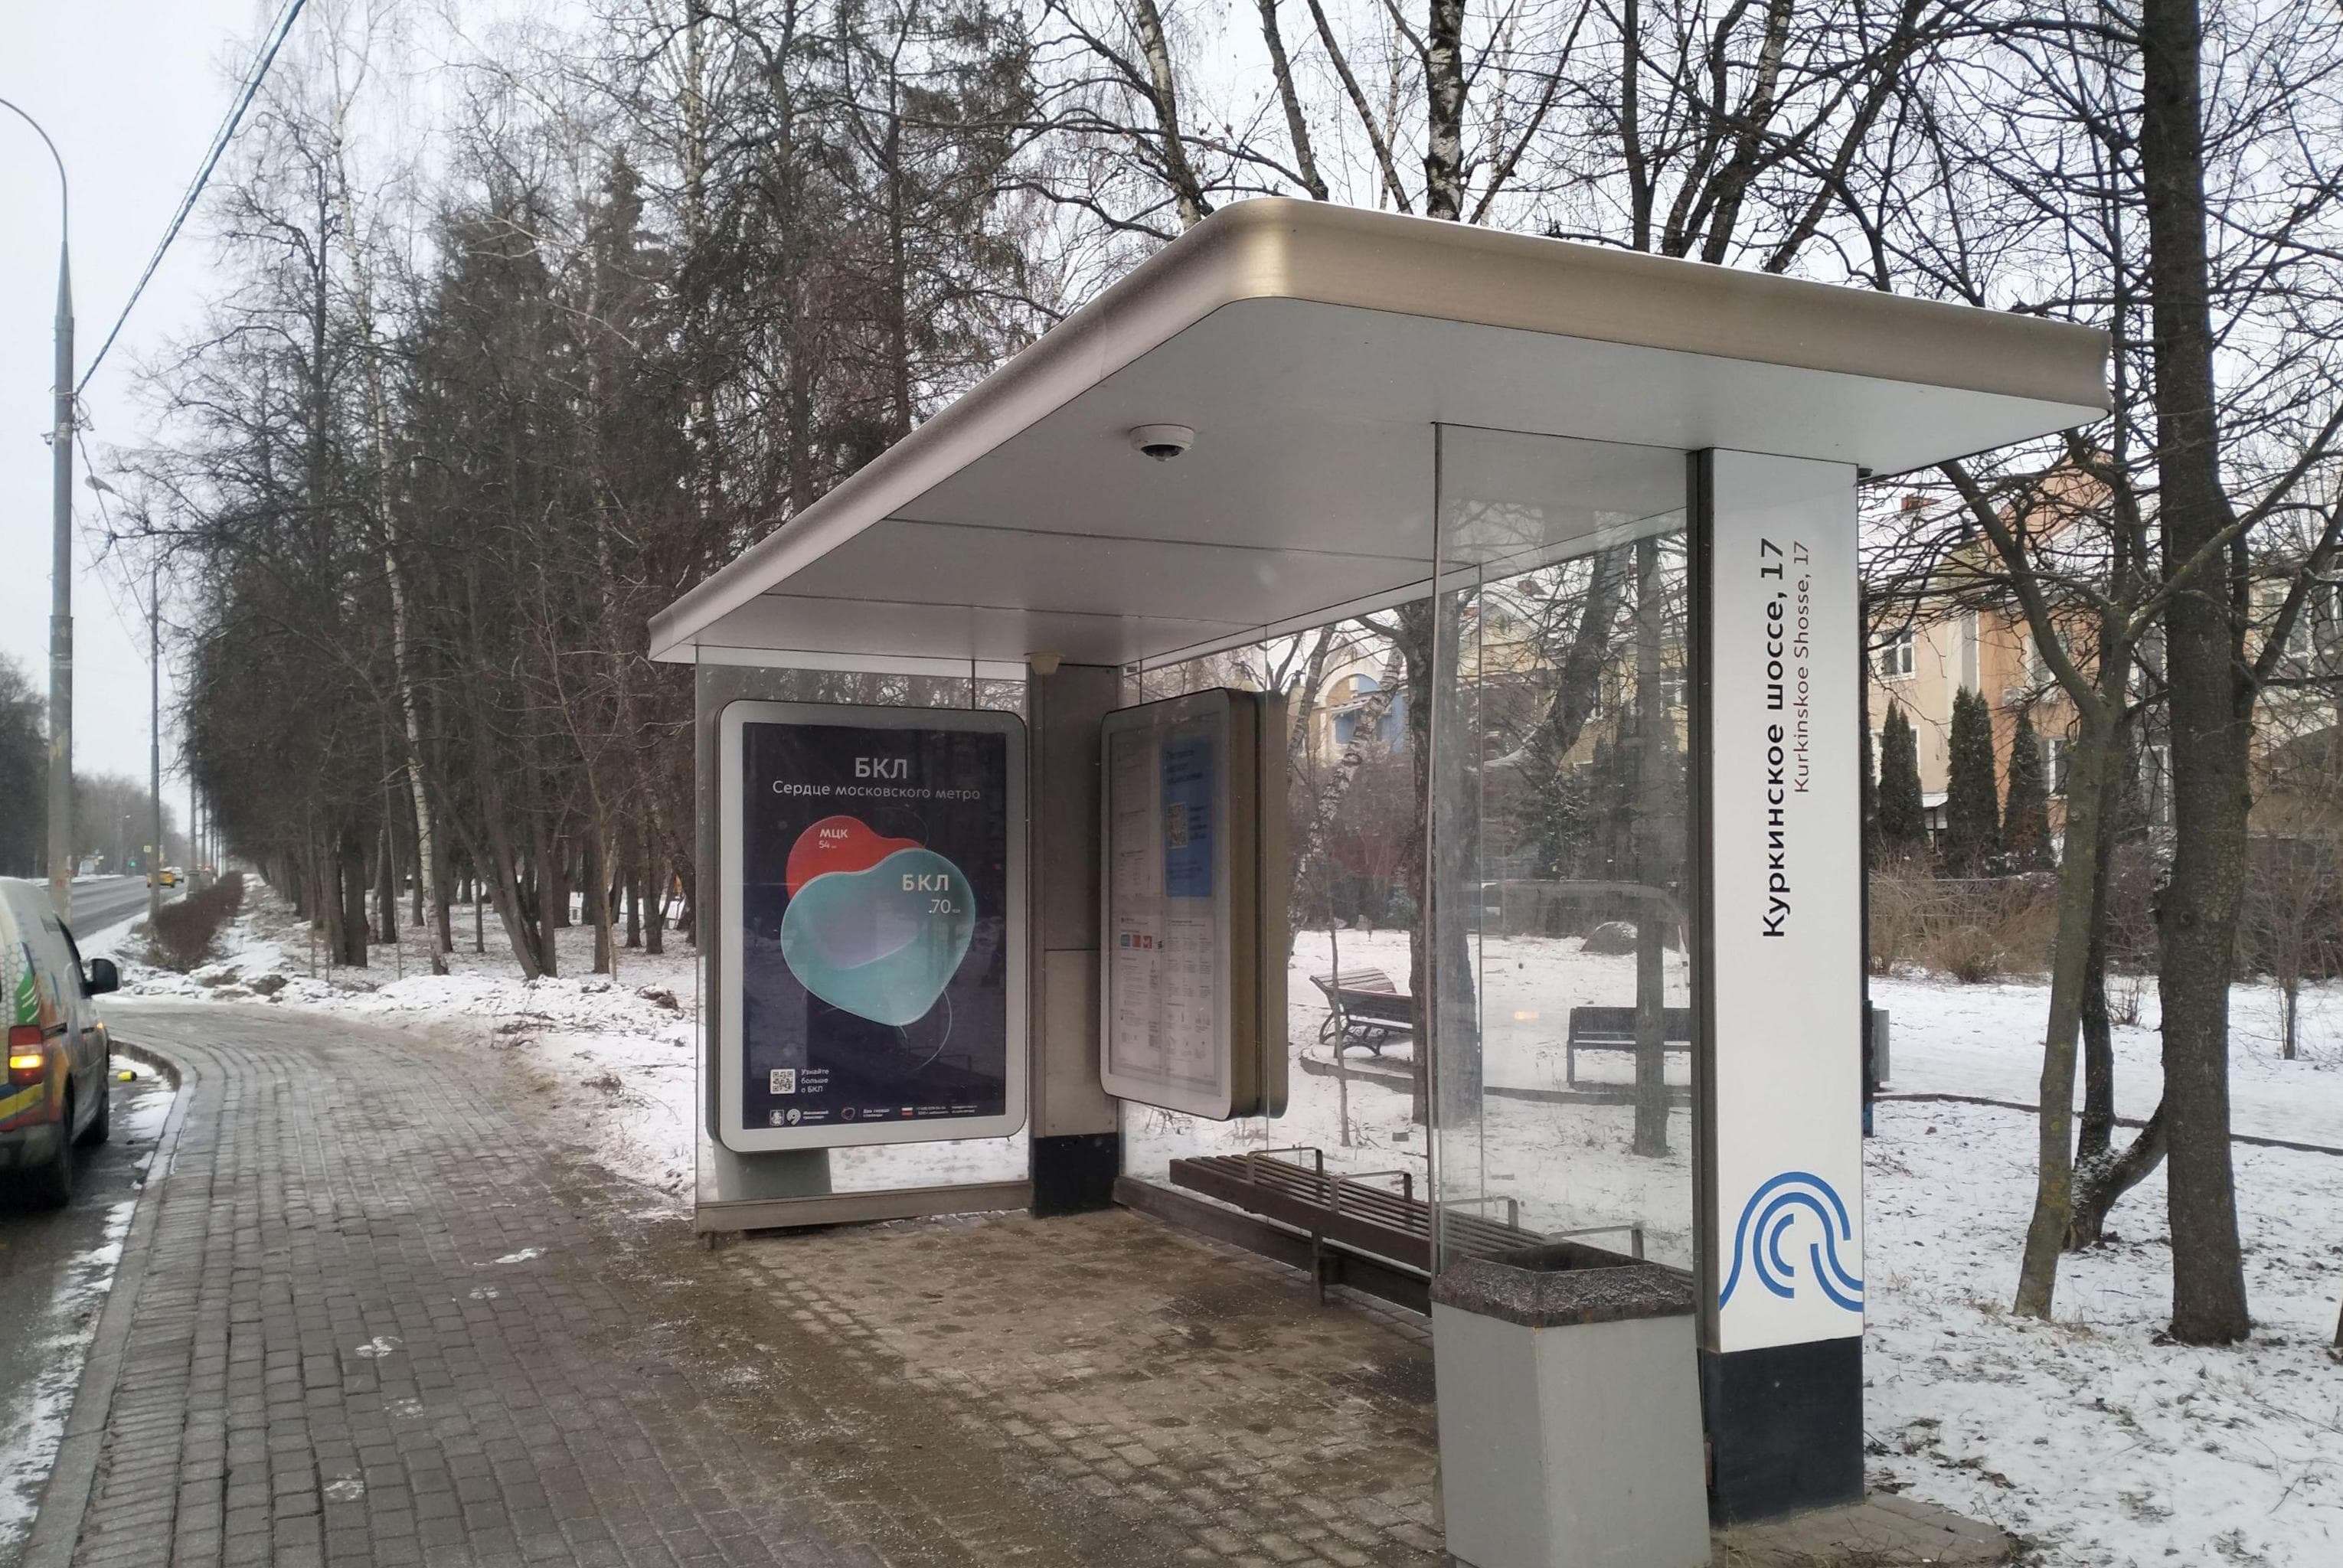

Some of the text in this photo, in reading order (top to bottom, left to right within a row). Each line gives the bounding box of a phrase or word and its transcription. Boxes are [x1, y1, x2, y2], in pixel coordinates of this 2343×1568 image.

[1792, 540, 1812, 792] Kurkinskoe Shosse, 17
[1760, 537, 1791, 937] Куркинское шоссе, 17
[855, 756, 907, 779] БКЛ
[772, 779, 981, 802] Сердце московского метро
[819, 828, 848, 840] МЦК
[819, 840, 830, 849] 54
[902, 873, 949, 892] БКЛ
[930, 898, 952, 914] 70
[807, 1085, 823, 1093] БКЛ
